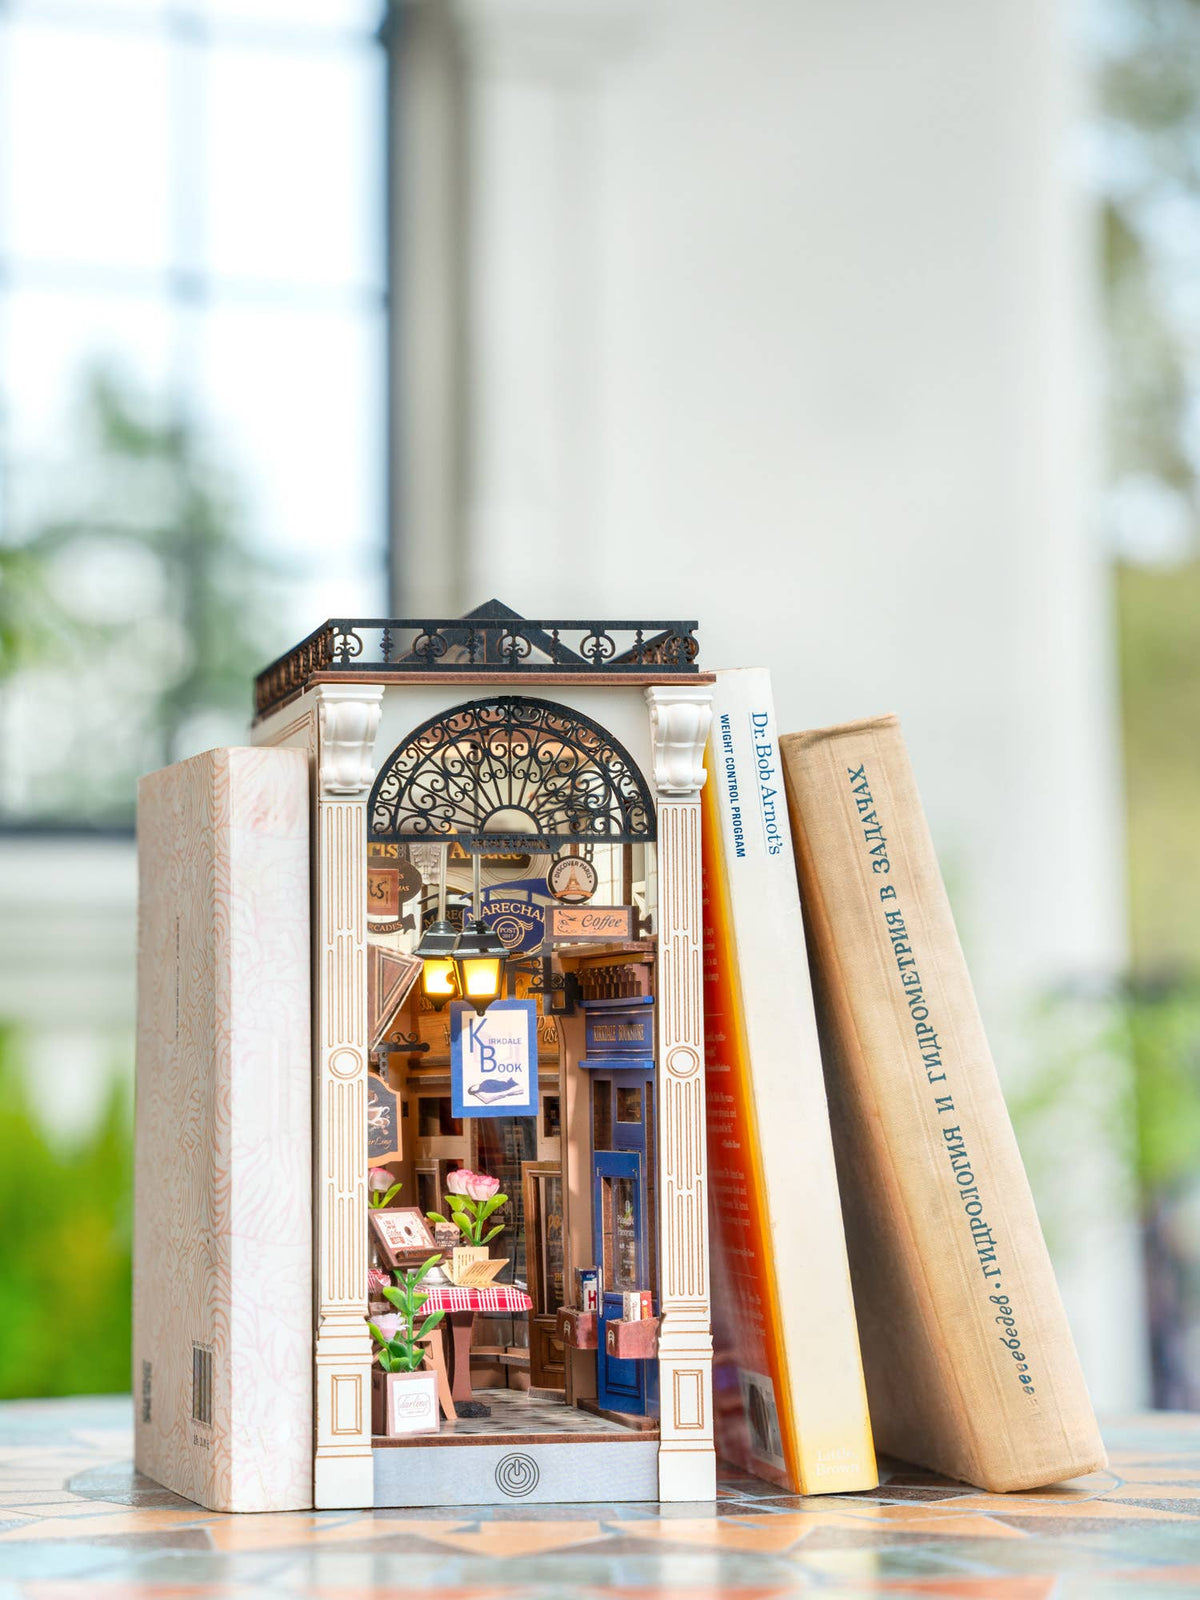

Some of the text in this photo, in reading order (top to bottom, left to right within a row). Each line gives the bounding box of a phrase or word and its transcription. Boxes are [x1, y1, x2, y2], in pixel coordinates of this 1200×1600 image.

[720, 714, 746, 858] WEIGHT CONTROL PROGRAM
[752, 712, 783, 856] Dr. Bob Arnot's
[847, 763, 891, 874] ЗАДАЧАХ
[554, 860, 593, 879] DISCOVER PARIS
[880, 885, 897, 902] В
[466, 902, 545, 922] MARECHA
[581, 914, 622, 930] Coffee
[884, 909, 947, 1085] ГИДРОМЕТРИЯ
[934, 1095, 955, 1114] И
[942, 1125, 1002, 1280] ГИДРОЛОГИЯ
